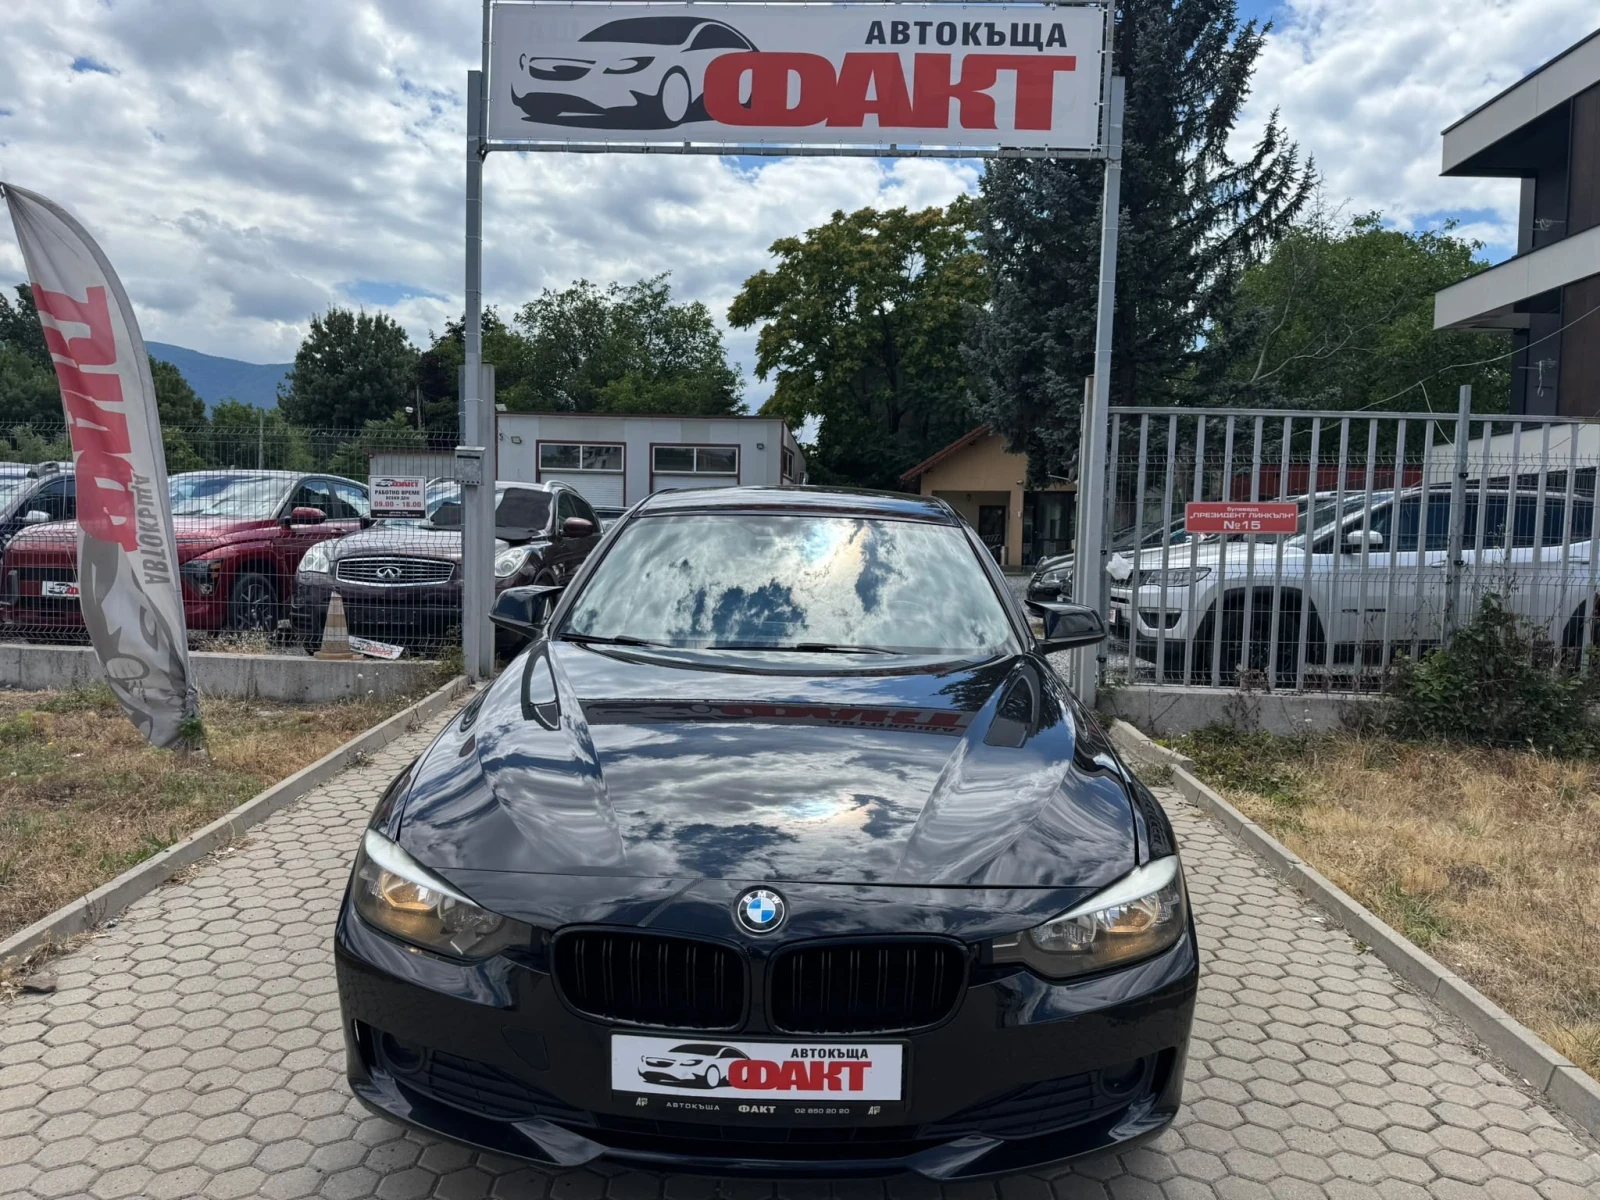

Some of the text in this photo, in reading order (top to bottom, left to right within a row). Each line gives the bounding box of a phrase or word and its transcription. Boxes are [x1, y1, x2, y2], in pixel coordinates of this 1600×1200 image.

[865, 20, 1068, 51] АВТОКЪЩА
[703, 51, 1077, 131] ФАКТ
[742, 890, 782, 904] BMW
[790, 1048, 869, 1060] АВТОКЪЩА
[727, 1059, 873, 1092] ФАКТ
[738, 1104, 776, 1113] ФАКТ
